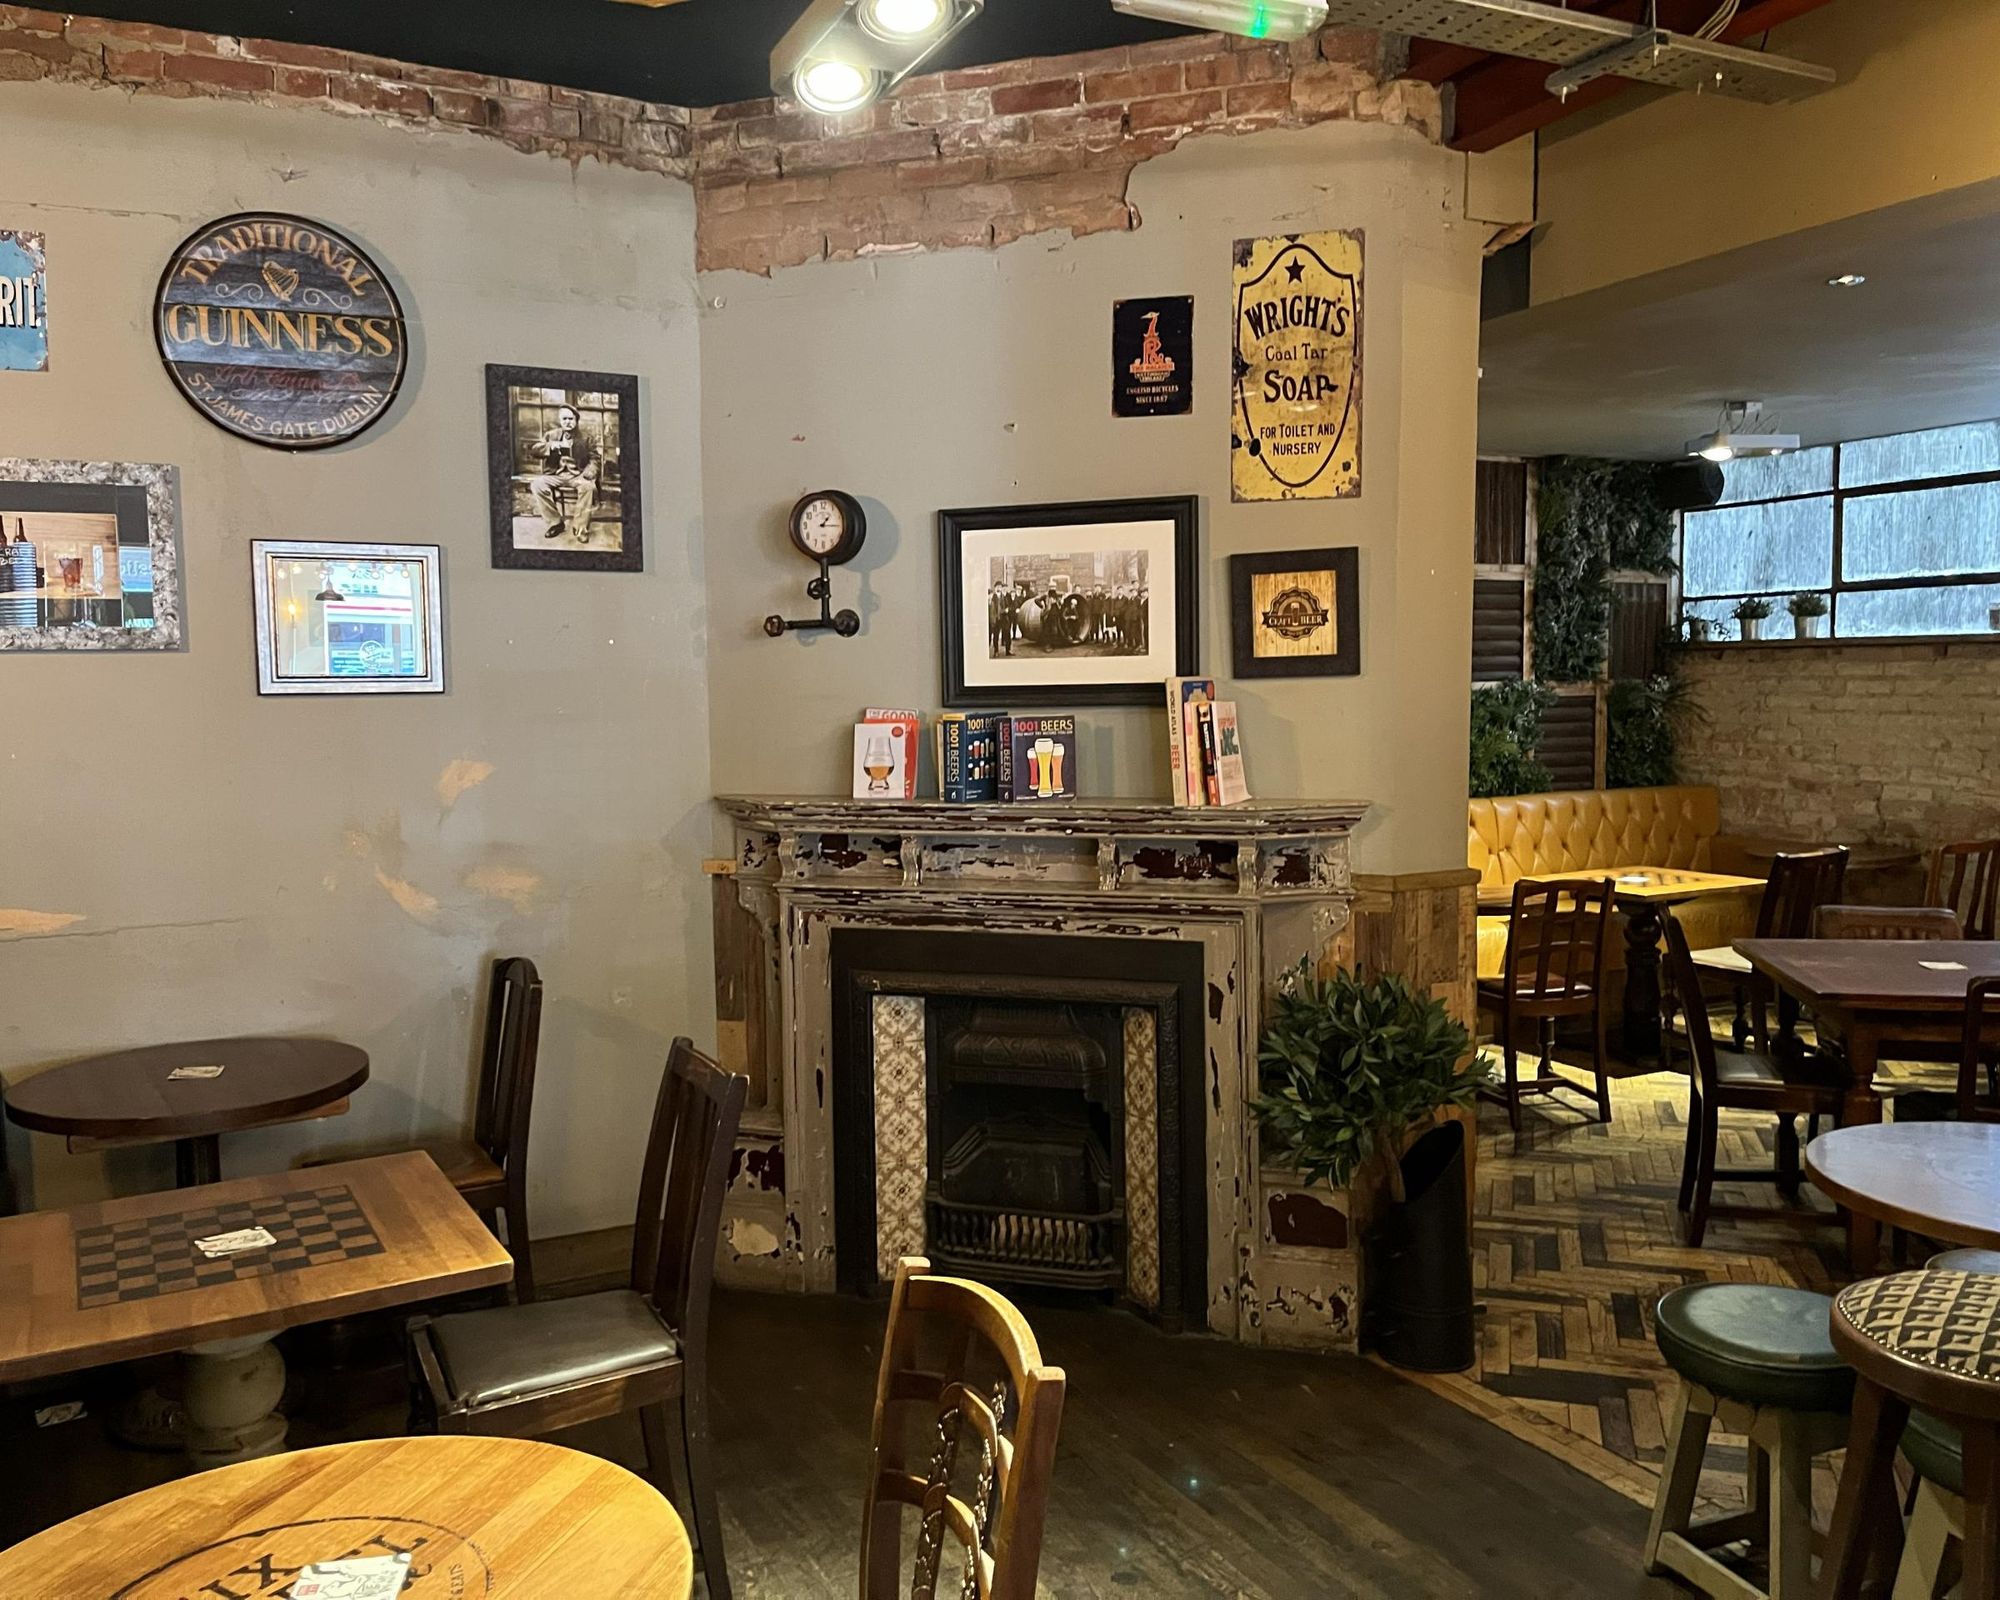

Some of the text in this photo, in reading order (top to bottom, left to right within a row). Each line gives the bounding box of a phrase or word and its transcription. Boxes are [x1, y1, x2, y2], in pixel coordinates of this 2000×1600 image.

[181, 223, 373, 296] TRADITIONAL
[1244, 295, 1350, 341] WRIGHT'S
[168, 304, 393, 358] GUINNESS
[1265, 342, 1328, 362] Coal Tar
[1263, 369, 1329, 403] SOAP
[205, 394, 265, 432] JAMES
[269, 420, 319, 438] GATE
[322, 385, 384, 434] DUBLIN
[1260, 423, 1335, 439] FOR TOILET AND
[1272, 442, 1321, 456] NURSERY
[1300, 615, 1324, 625] BEER
[950, 723, 959, 747] 1001
[967, 718, 984, 730] 1001
[1014, 719, 1073, 732] 1001 BEERS
[950, 749, 960, 783] BEERS
[1003, 748, 1012, 782] BEERS
[1172, 744, 1180, 769] BEER
